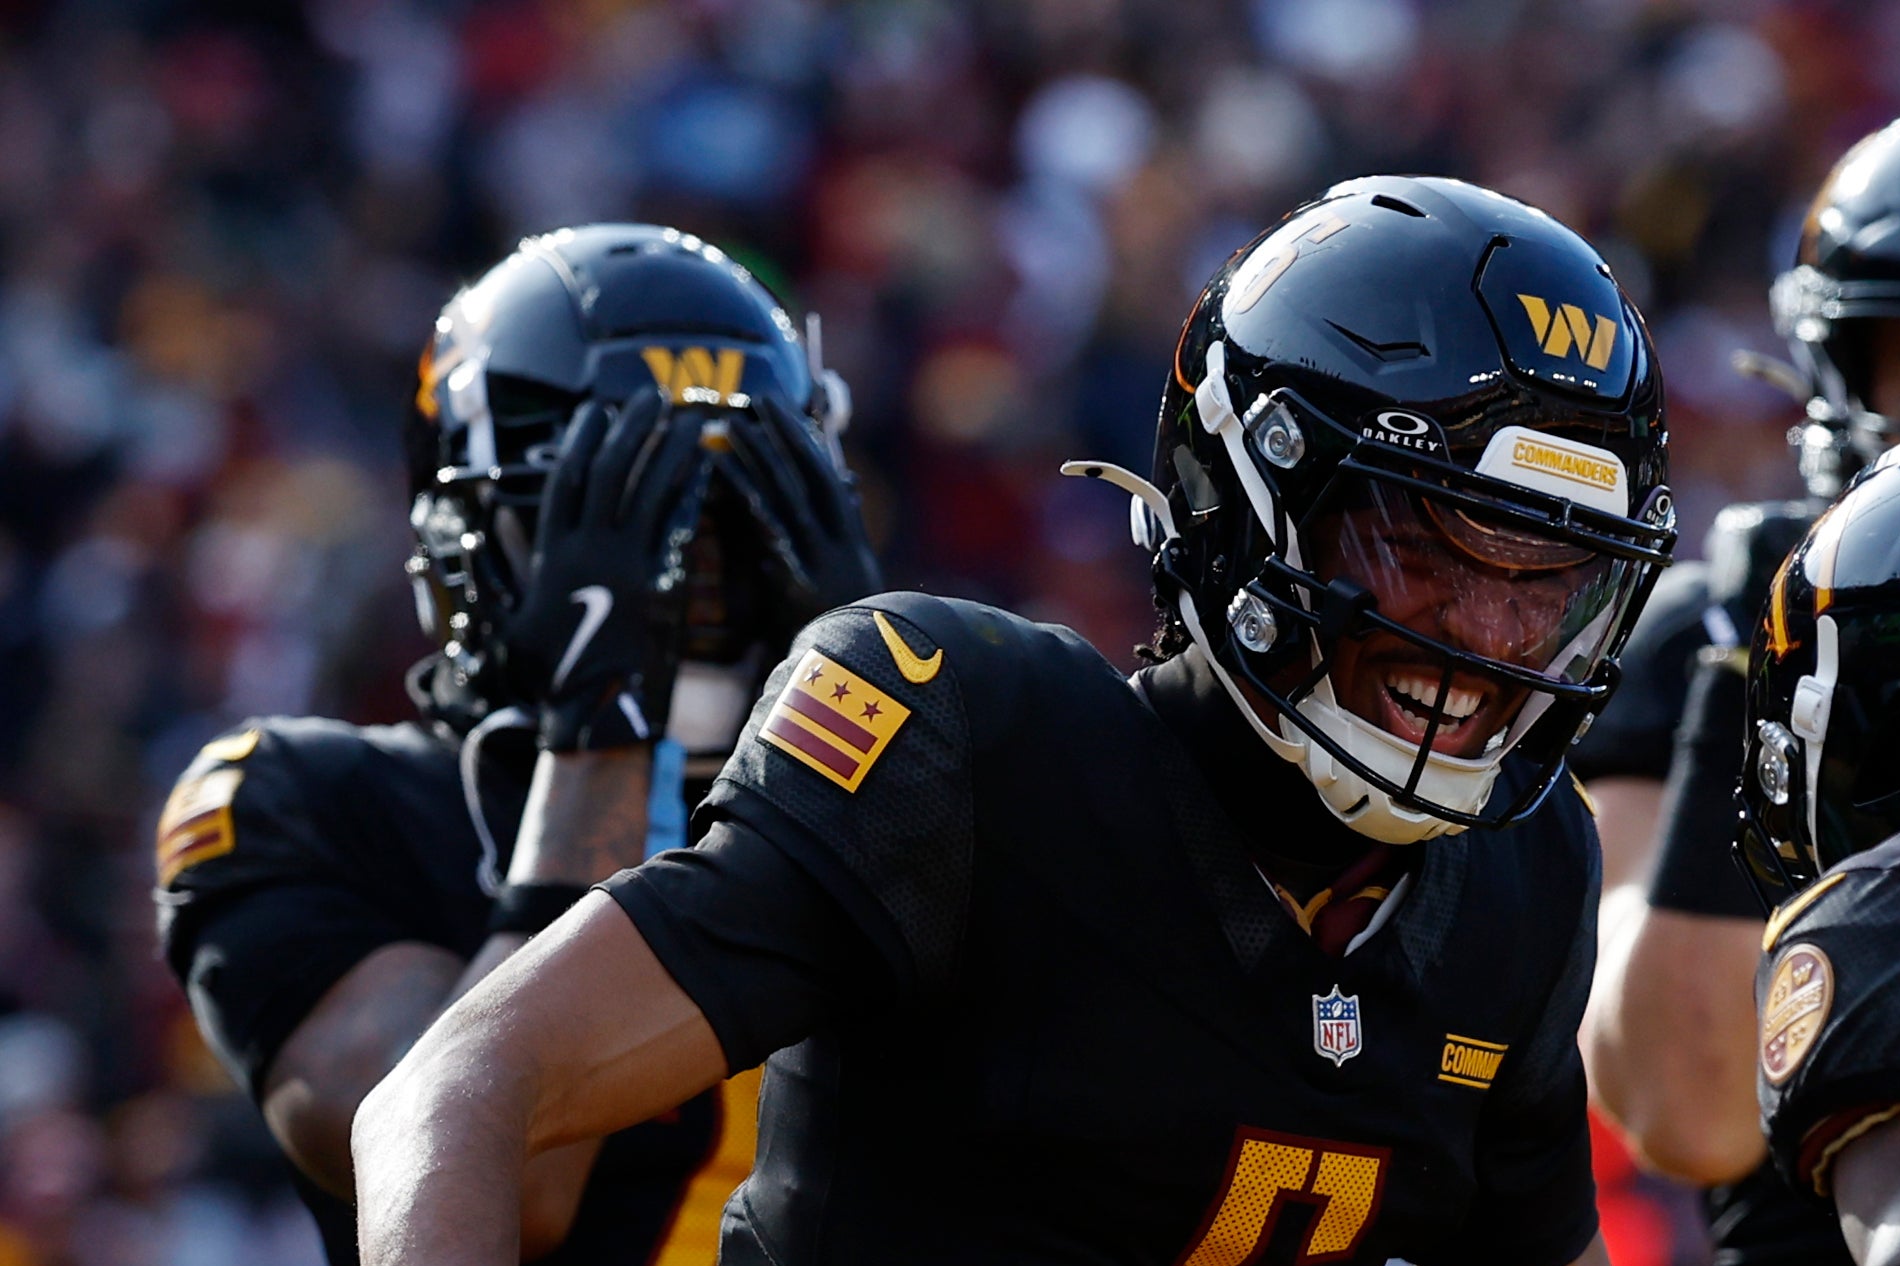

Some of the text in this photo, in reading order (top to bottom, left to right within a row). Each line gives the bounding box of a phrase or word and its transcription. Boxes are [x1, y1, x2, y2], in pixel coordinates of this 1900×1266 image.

[1516, 293, 1617, 372] W
[1363, 427, 1440, 452] OAKLEY
[1513, 442, 1619, 487] COMMANDERS
[1321, 1022, 1356, 1051] NFL
